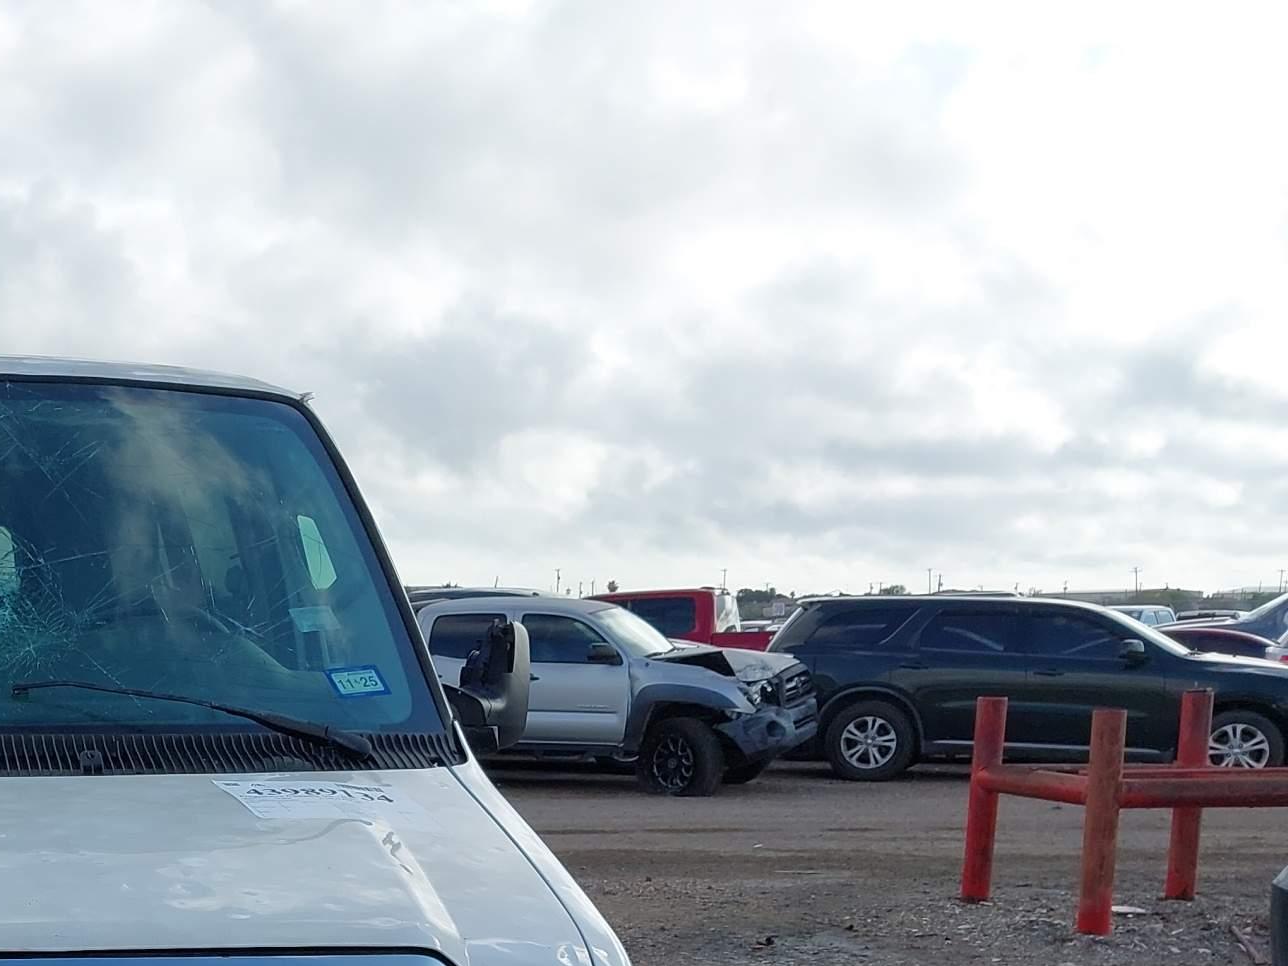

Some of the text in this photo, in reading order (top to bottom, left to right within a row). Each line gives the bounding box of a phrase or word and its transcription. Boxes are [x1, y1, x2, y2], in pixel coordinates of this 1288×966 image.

[337, 675, 379, 690] 11 25
[245, 788, 394, 803] 43989134
